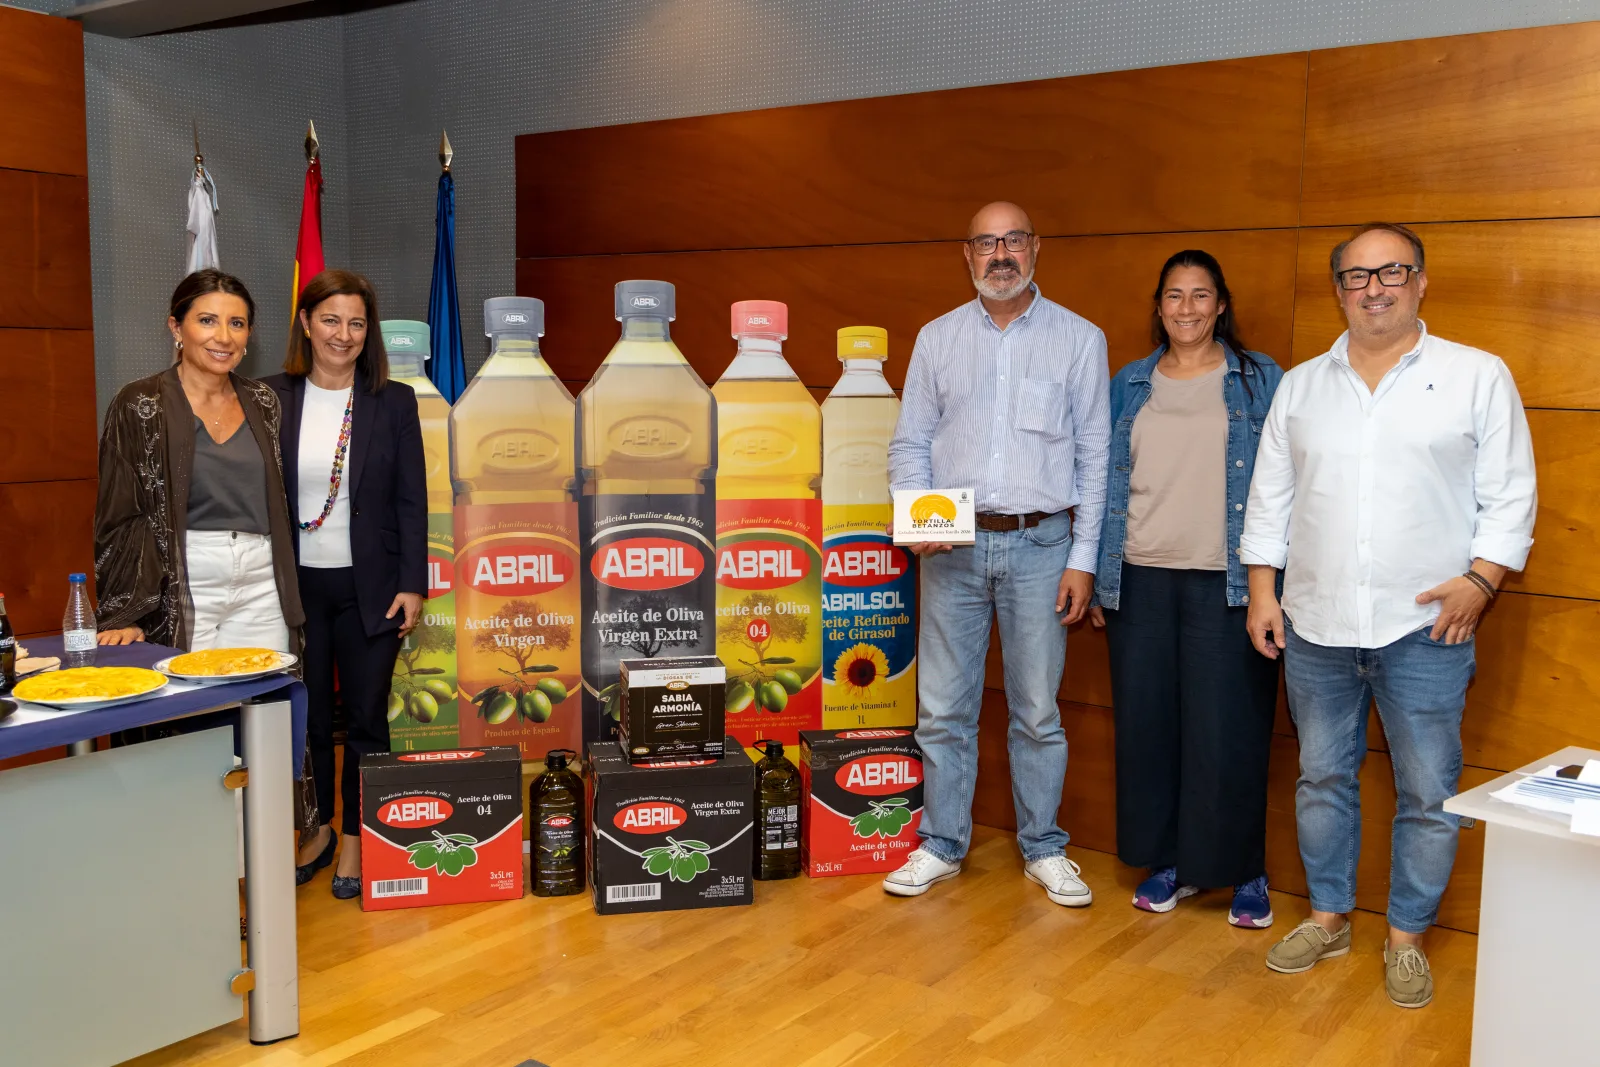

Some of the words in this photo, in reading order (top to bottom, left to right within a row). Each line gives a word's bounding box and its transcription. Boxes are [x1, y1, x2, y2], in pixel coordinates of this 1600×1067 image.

[634, 298, 656, 306] ABRIL
[505, 314, 526, 323] ABRIL
[748, 317, 769, 325] ABRIL
[854, 340, 872, 349] ABRIL
[498, 520, 532, 529] Familiar
[533, 521, 553, 530] desde
[664, 512, 685, 522] desde
[687, 516, 704, 528] 1962
[741, 516, 772, 524] Familiar
[774, 517, 793, 526] desde
[795, 521, 811, 532] 1962
[846, 520, 874, 528] Familiar
[602, 547, 694, 578] ABRIL
[716, 550, 802, 579] ABRIL
[824, 550, 900, 577] ABRIL
[473, 555, 564, 586] ABRIL
[822, 591, 904, 611] ABRILSOL
[716, 603, 750, 616] ceite
[754, 602, 772, 615] de
[776, 602, 810, 615] Oliva
[464, 615, 510, 630] Aceite
[514, 614, 532, 627] de
[536, 612, 574, 626] Oliva
[592, 609, 638, 624] Aceite
[642, 608, 662, 622] de
[666, 608, 704, 621] Oliva
[822, 616, 850, 628] ceite
[854, 612, 910, 627] Refinado
[598, 629, 650, 645] Virgen
[654, 627, 698, 641] Extra
[749, 624, 768, 638] 04
[829, 629, 845, 640] de
[848, 627, 896, 640] Girasol
[493, 634, 545, 649] Virgen
[662, 694, 693, 702] SABIA
[653, 702, 702, 713] ARMONÍA
[861, 701, 891, 709] Vitamina
[858, 715, 865, 724] 1L
[484, 729, 519, 737] Producto
[533, 726, 560, 735] España
[846, 730, 905, 738] ABRIL
[405, 740, 414, 750] 1L
[519, 742, 528, 752] 1L
[407, 751, 475, 761] ABRIL
[839, 748, 865, 760] Tradición
[846, 761, 918, 787] ABRIL
[387, 802, 446, 822] ABRIL
[477, 804, 492, 816] 04
[623, 807, 680, 827] ABRIL
[850, 844, 875, 852] Aceite
[890, 840, 910, 848] Oliva
[873, 851, 886, 861] 04
[816, 862, 832, 872] 3x5L
[490, 871, 505, 879] 3x5L
